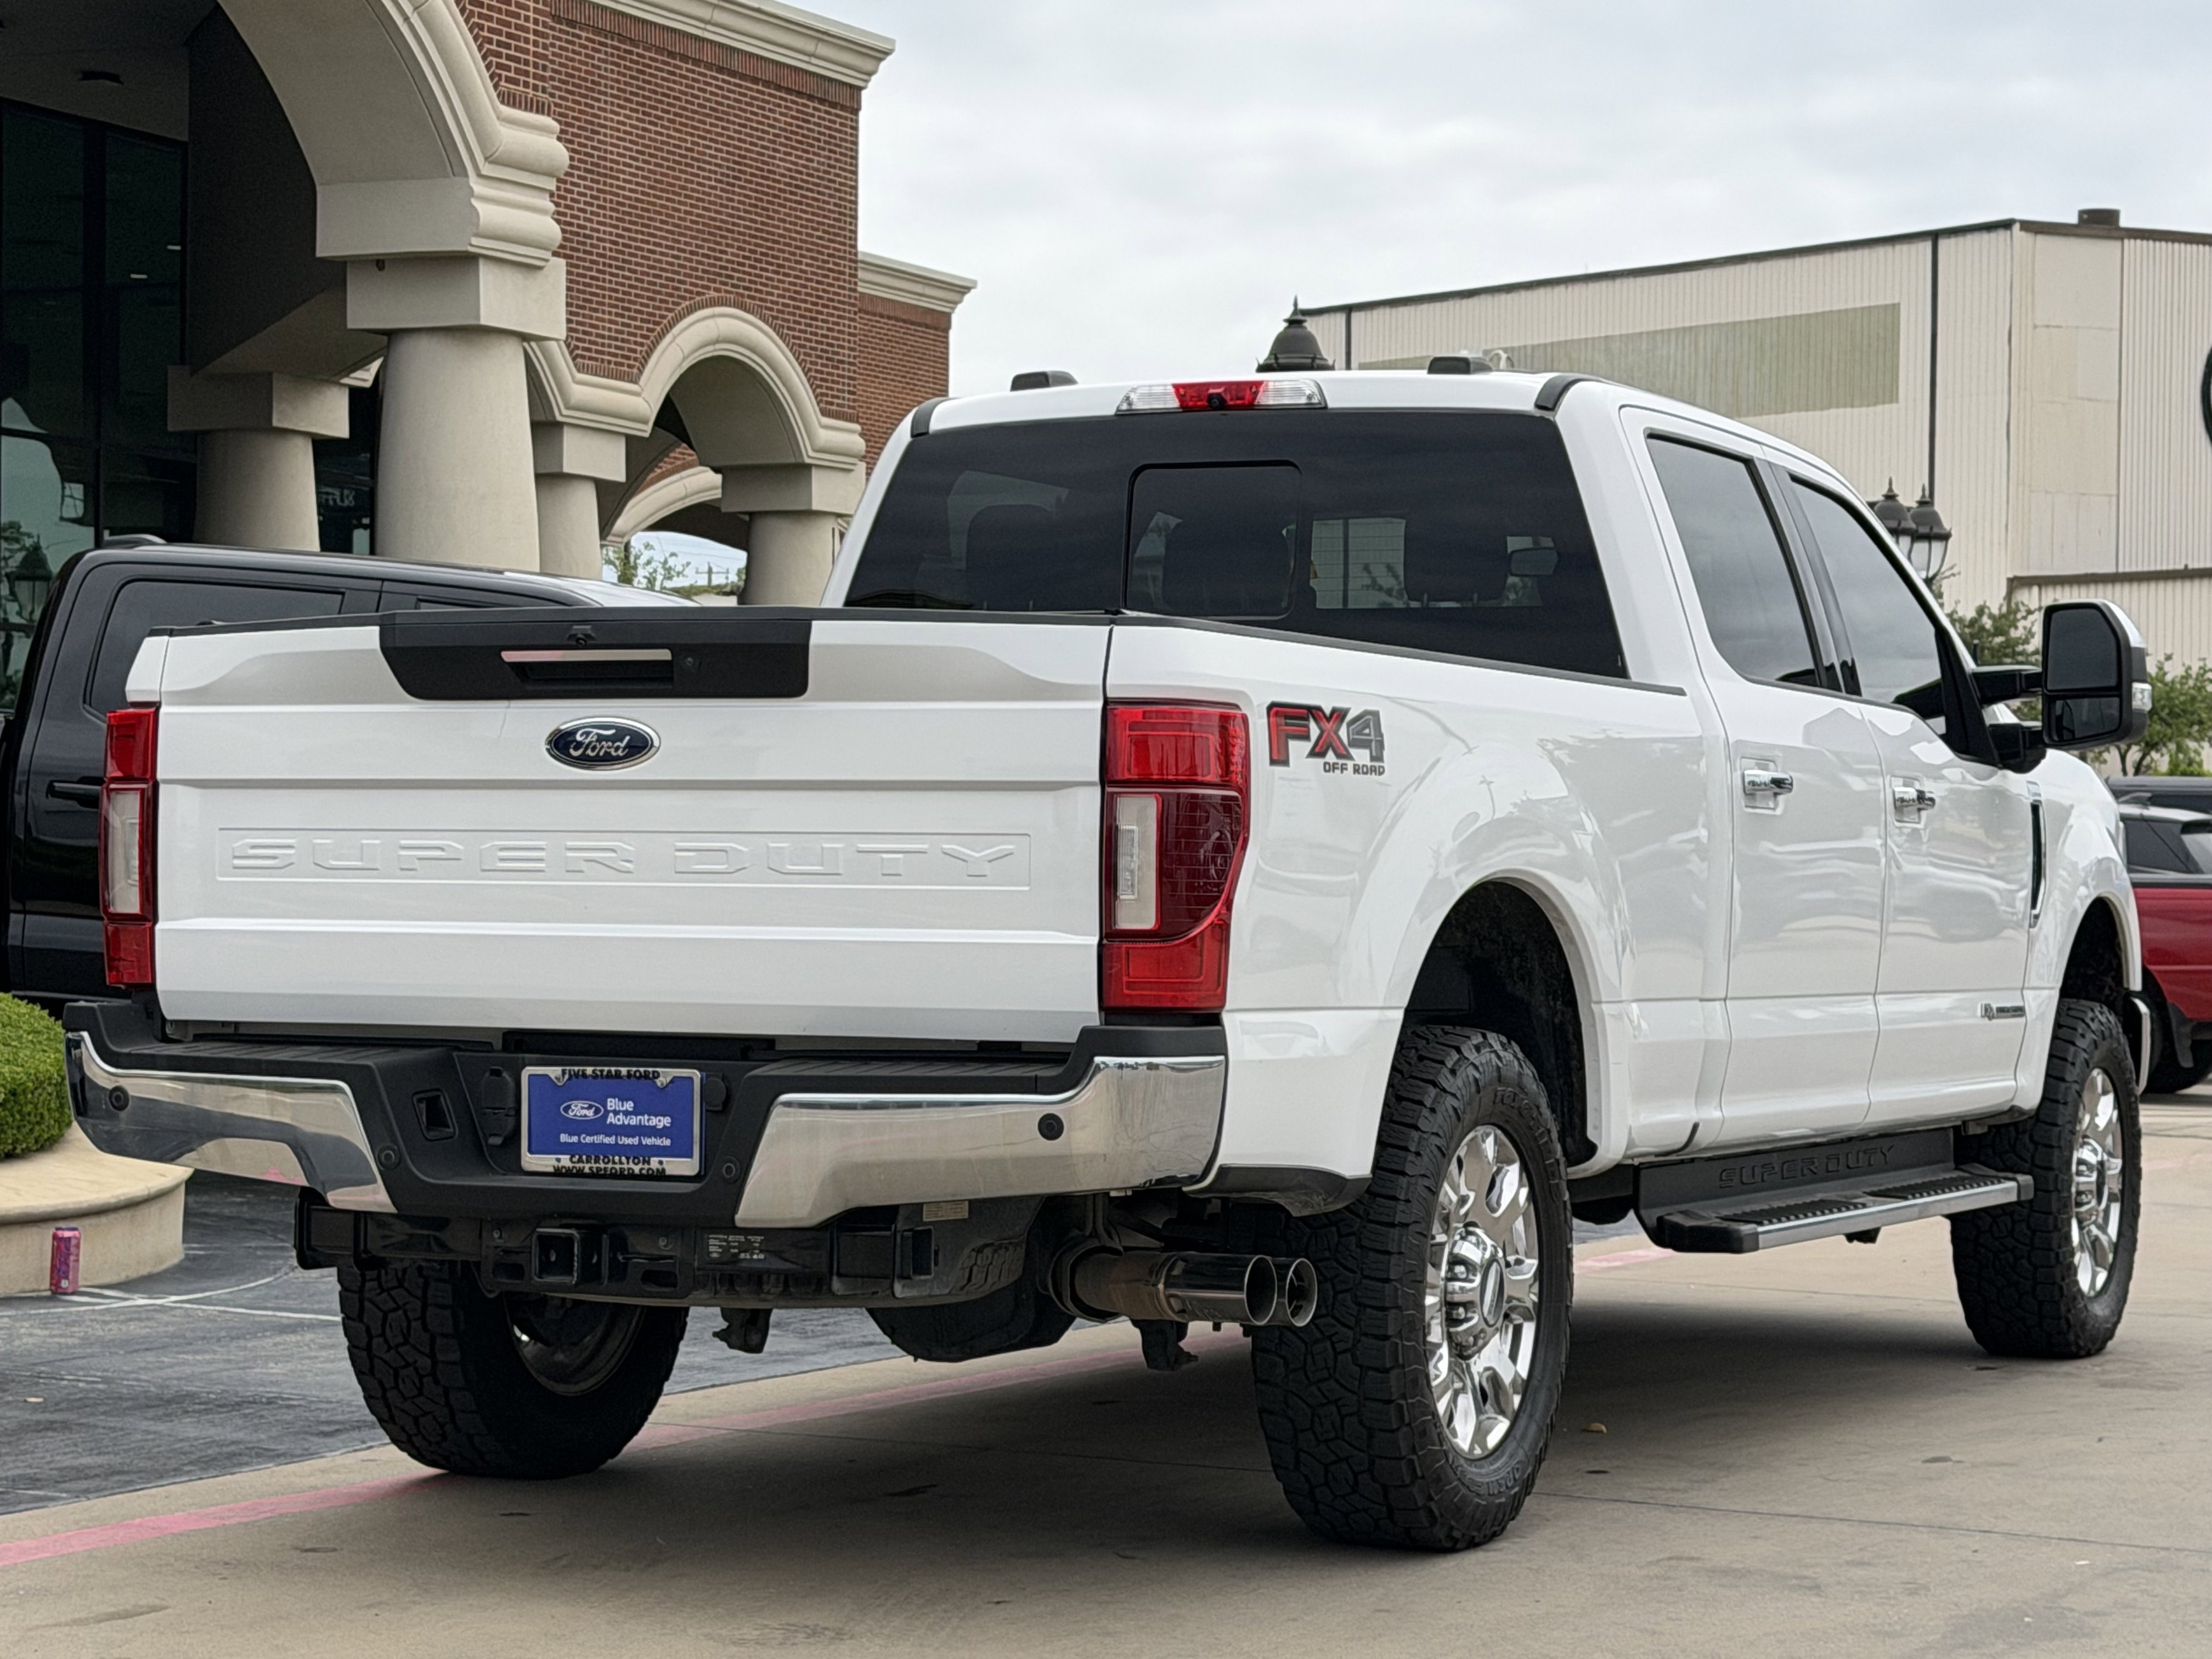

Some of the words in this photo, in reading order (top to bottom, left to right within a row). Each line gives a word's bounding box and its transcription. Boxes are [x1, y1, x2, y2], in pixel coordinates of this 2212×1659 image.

[569, 727, 631, 757] Ford
[1266, 701, 1385, 768] FX4
[1323, 761, 1348, 774] OFF
[1353, 763, 1385, 776] ROAD
[232, 838, 635, 873] SUPER
[674, 842, 1015, 877] DUTY
[561, 1068, 588, 1080] FIVE
[592, 1068, 623, 1080] STAR
[627, 1069, 661, 1080] FORD
[568, 1103, 596, 1116] Ford
[607, 1098, 634, 1111] Blue
[606, 1112, 672, 1128] Advantage
[560, 1133, 578, 1143] Blue
[580, 1134, 616, 1144] Certified
[618, 1136, 639, 1145] Used
[641, 1136, 672, 1146] Vehicle
[569, 1154, 651, 1166] CARROLLTON
[1719, 1157, 1820, 1189] SUPER
[1825, 1144, 1895, 1173] DUTY
